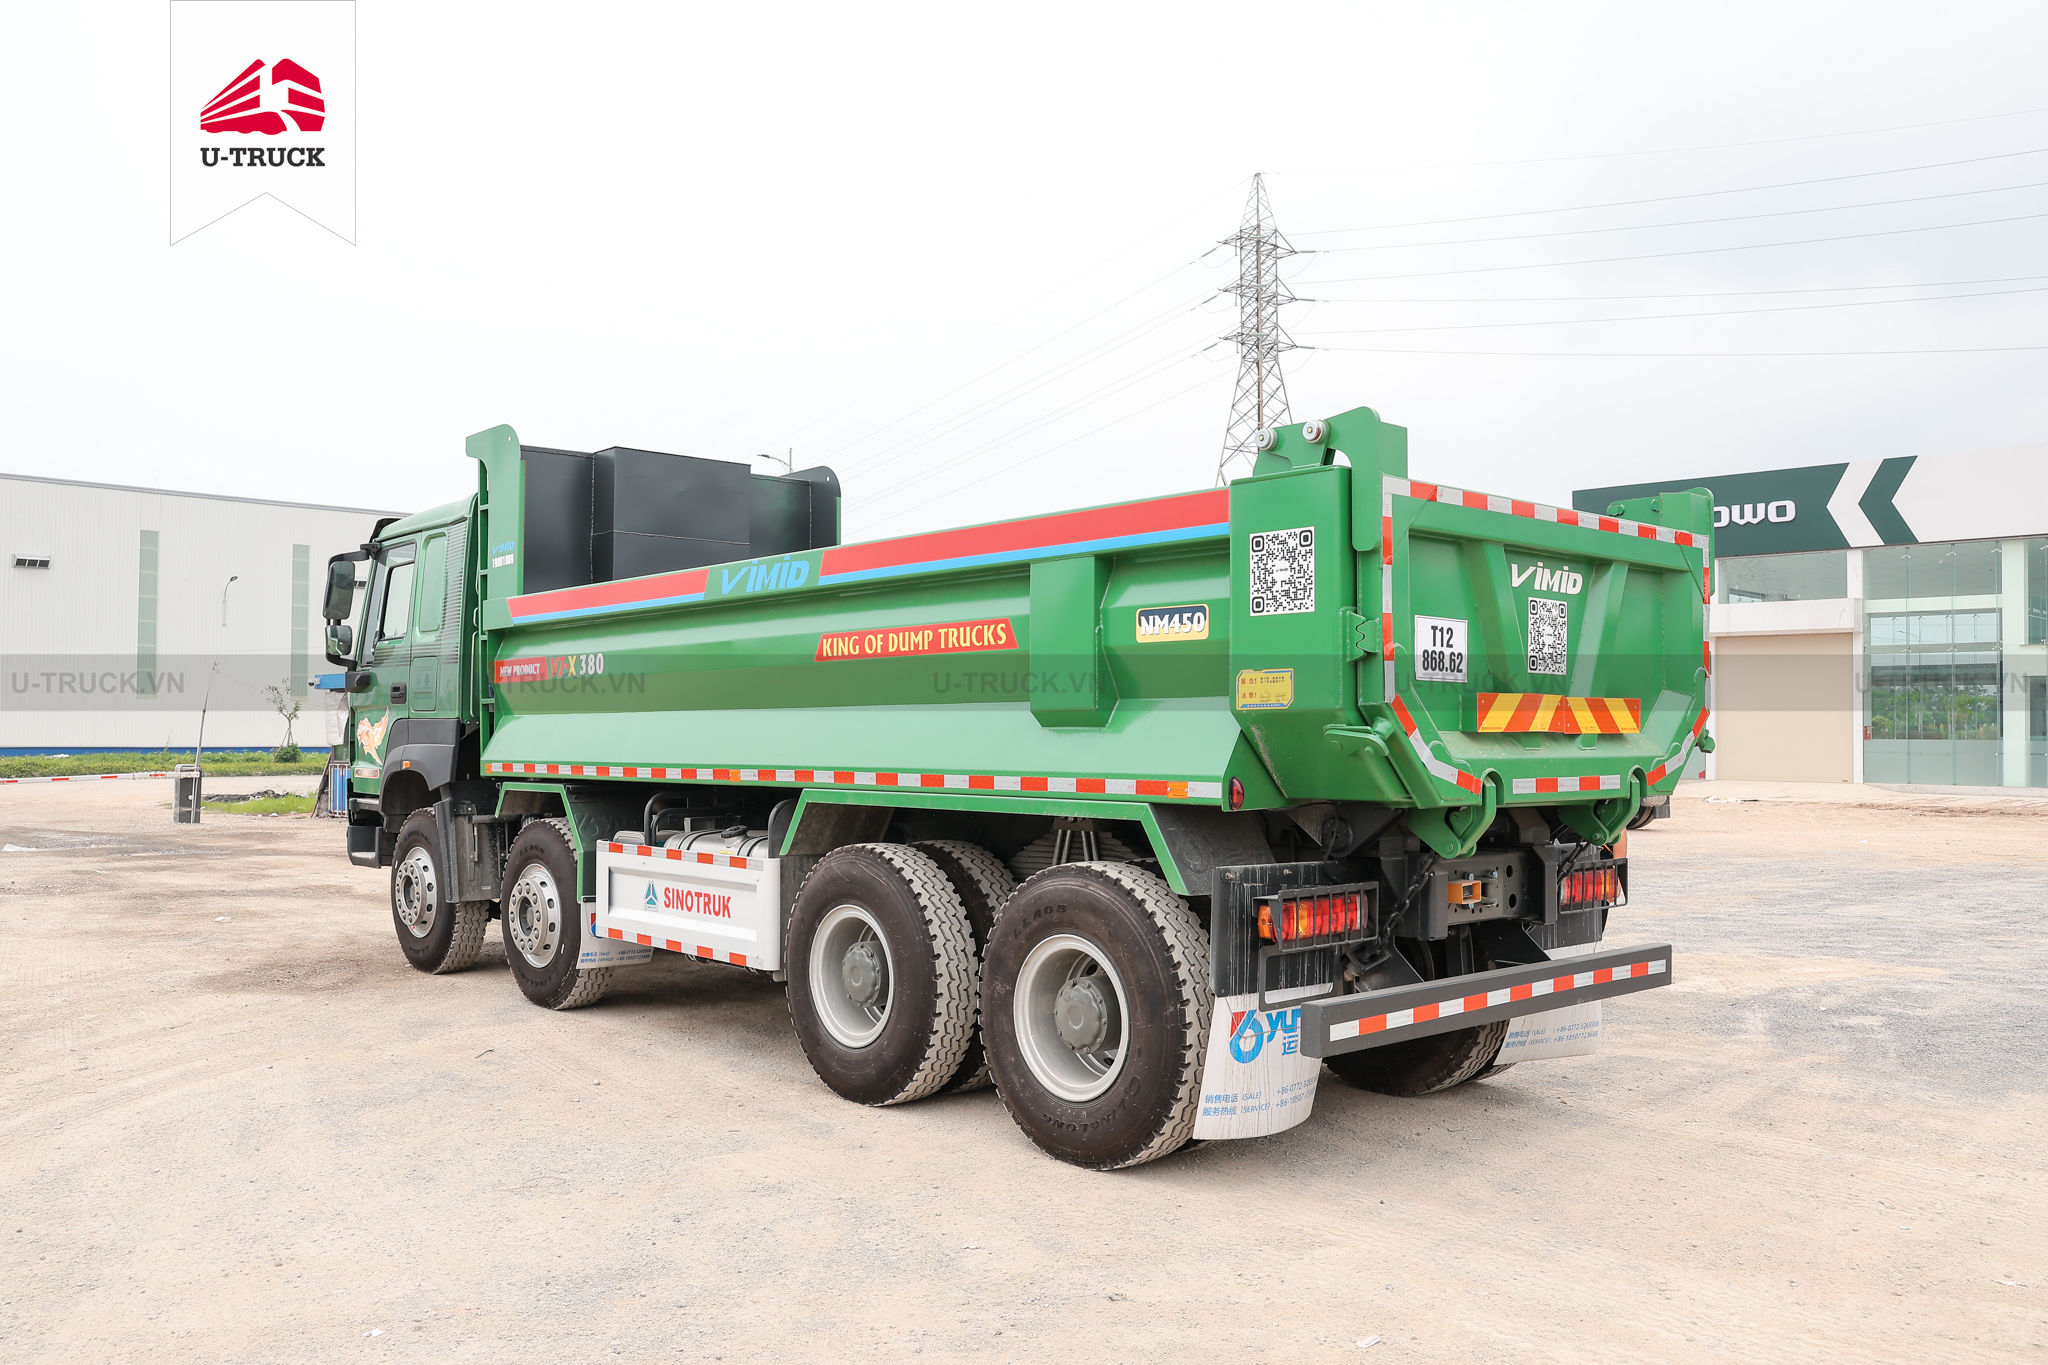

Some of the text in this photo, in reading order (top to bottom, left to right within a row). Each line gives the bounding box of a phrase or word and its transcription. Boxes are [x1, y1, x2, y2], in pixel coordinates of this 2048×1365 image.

[1140, 611, 1206, 636] NM450
[822, 623, 1007, 657] KING OF DUMP TRUCKS
[1431, 625, 1454, 648] T12
[499, 666, 513, 678] NEW
[513, 663, 541, 676] PRODUCT
[579, 653, 605, 676] 380
[1422, 649, 1464, 673] 868.62
[663, 886, 732, 919] SINOTRUK
[1205, 1093, 1239, 1104] 销售电话
